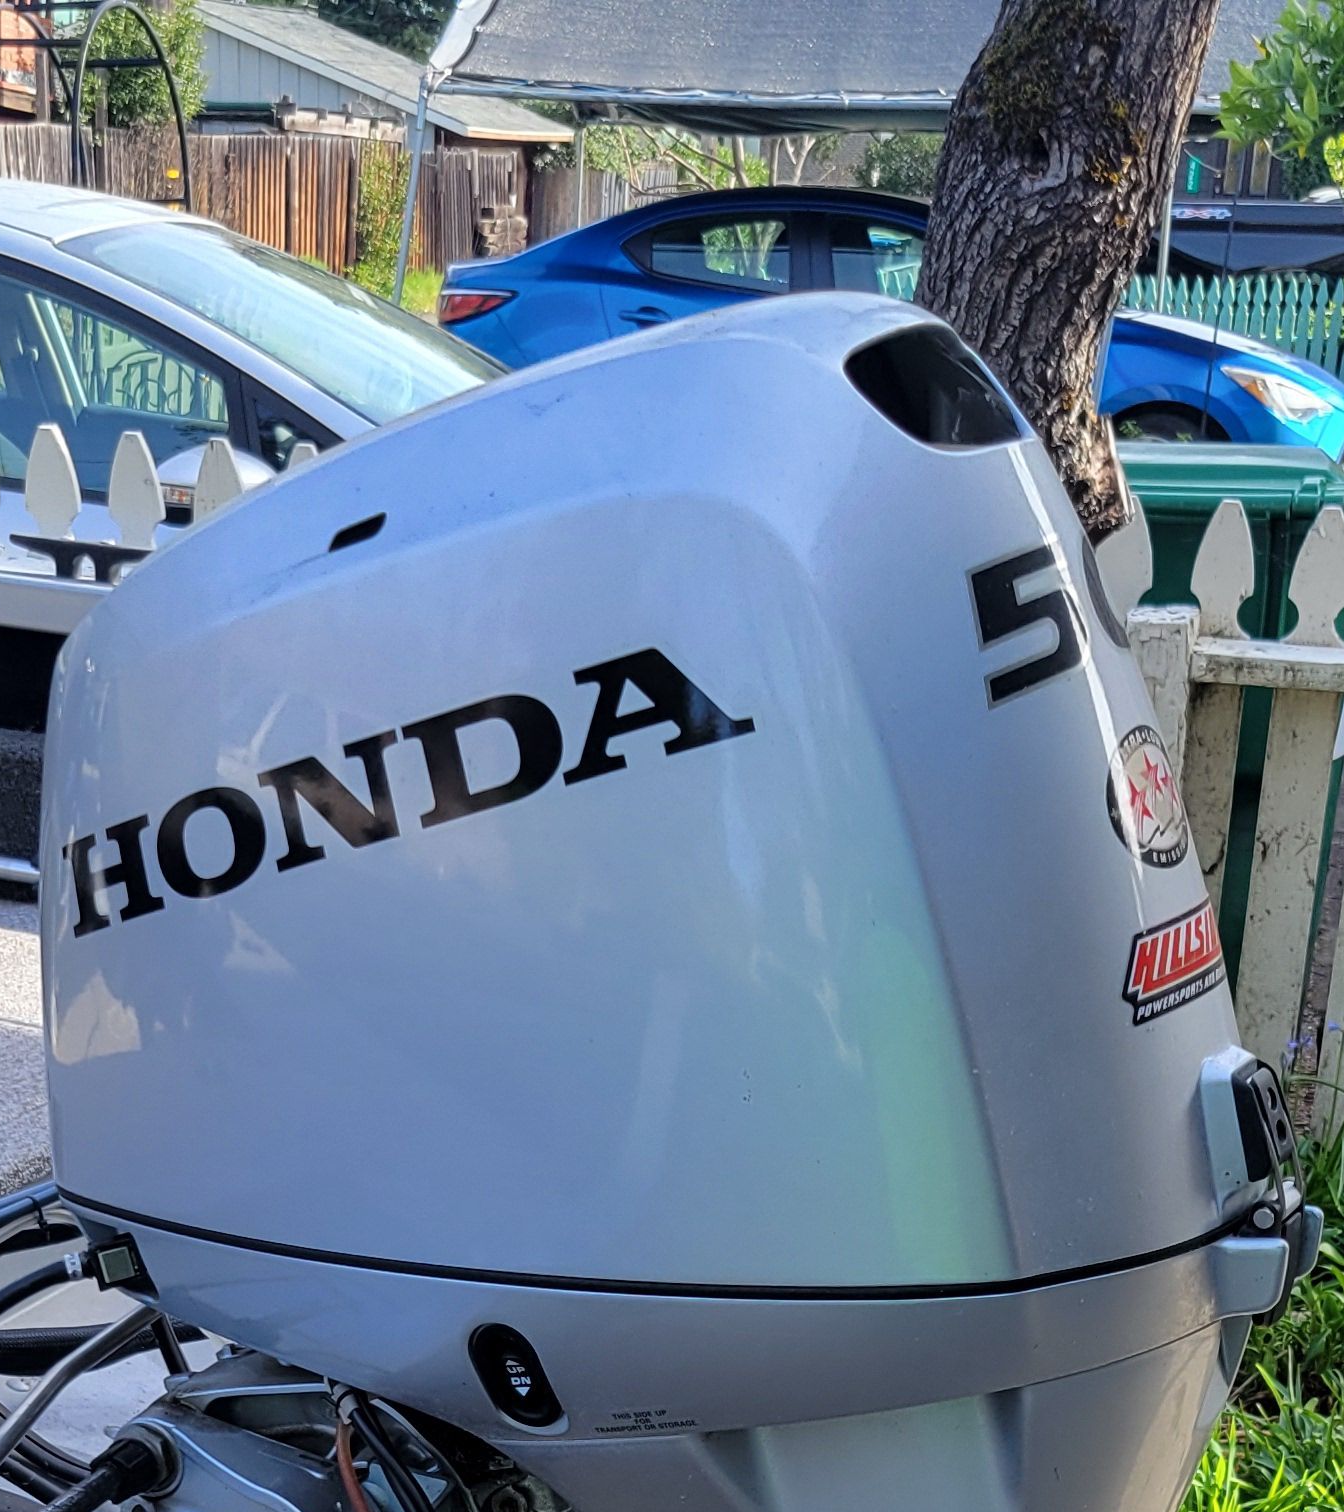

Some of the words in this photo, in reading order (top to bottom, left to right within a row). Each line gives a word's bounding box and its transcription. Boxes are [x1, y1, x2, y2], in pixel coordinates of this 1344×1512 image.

[62, 647, 755, 938] HONDA
[1137, 979, 1203, 1020] POWERSPORTS
[506, 1366, 526, 1374] UP
[511, 1376, 531, 1385] DN
[633, 1410, 653, 1419] SIDE
[655, 1409, 667, 1417] UP
[594, 1424, 643, 1433] TRANSPORT
[644, 1423, 656, 1431] OR
